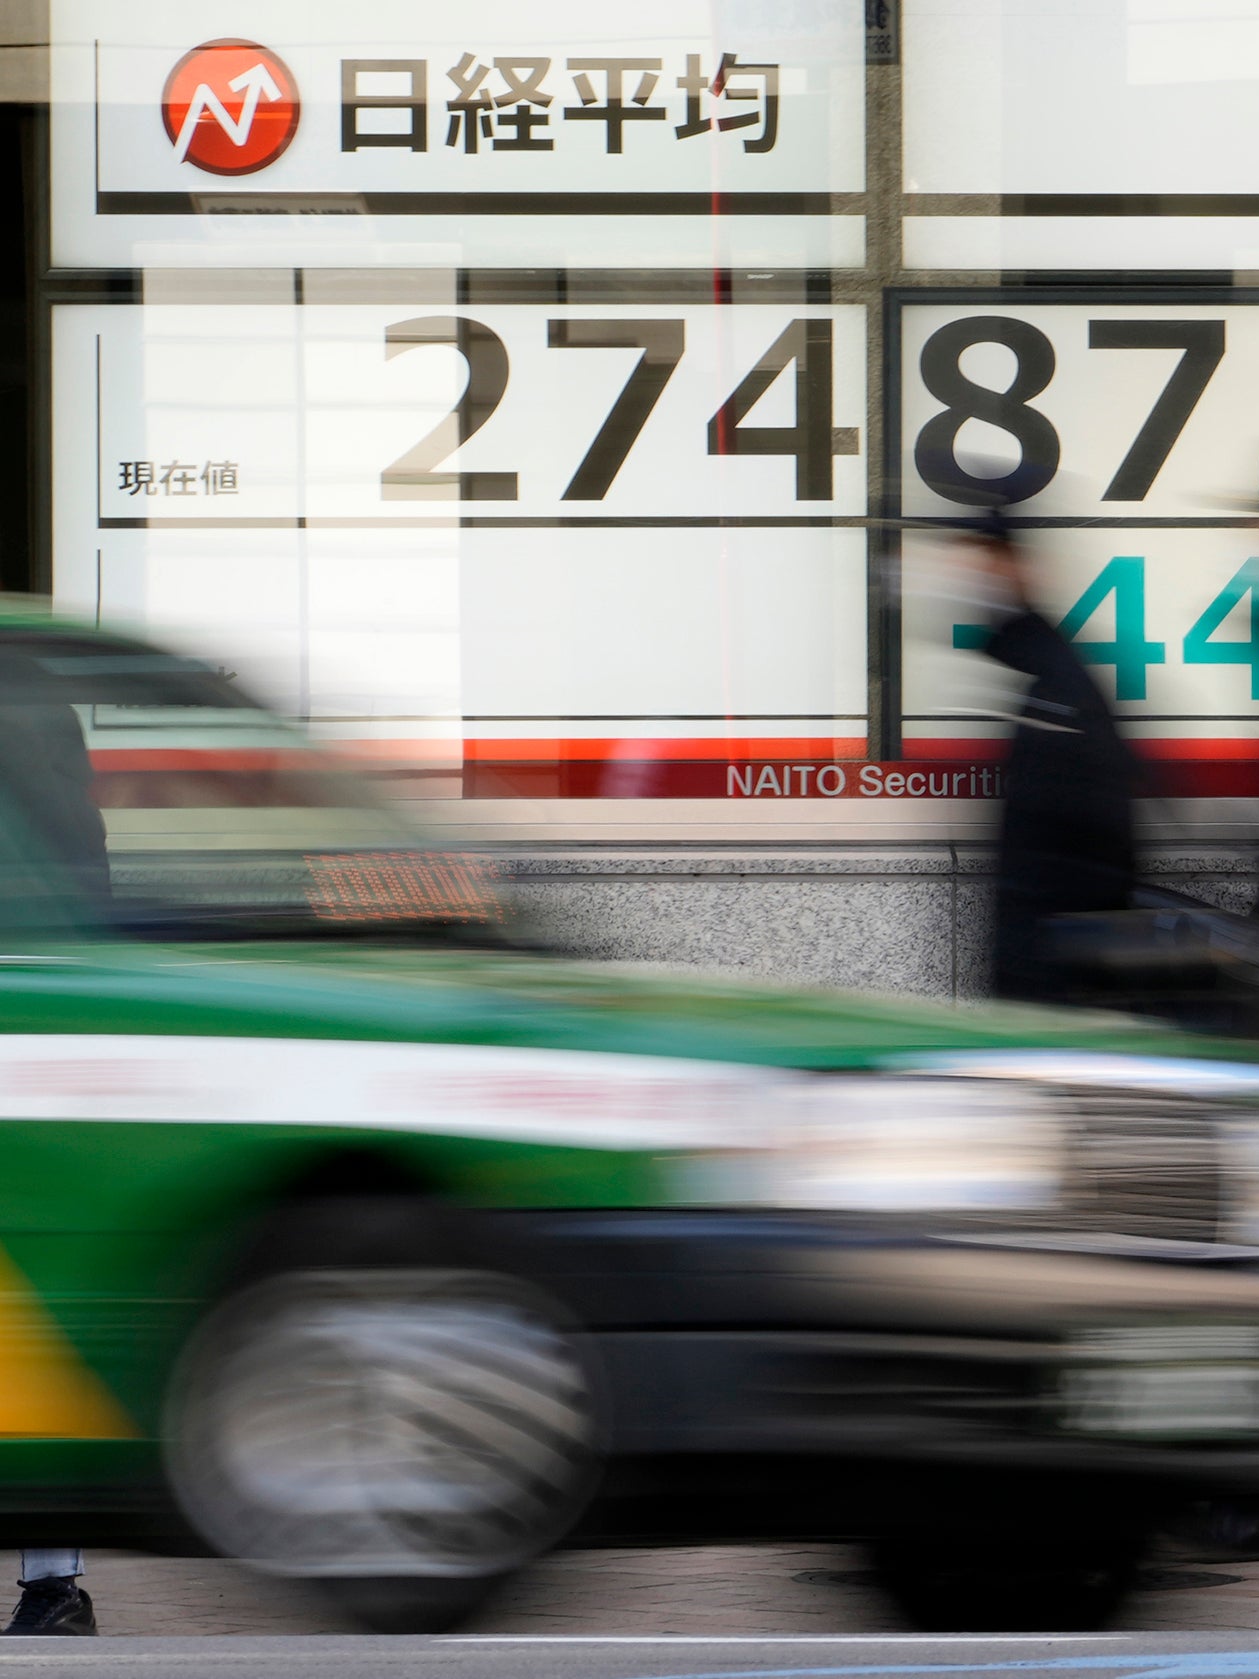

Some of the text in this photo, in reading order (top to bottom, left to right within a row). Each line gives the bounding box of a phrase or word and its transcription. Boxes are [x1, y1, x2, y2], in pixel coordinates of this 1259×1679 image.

[339, 52, 781, 155] 日経平均
[117, 460, 240, 497] 現在値
[727, 764, 1006, 797] NAITO Securiti
